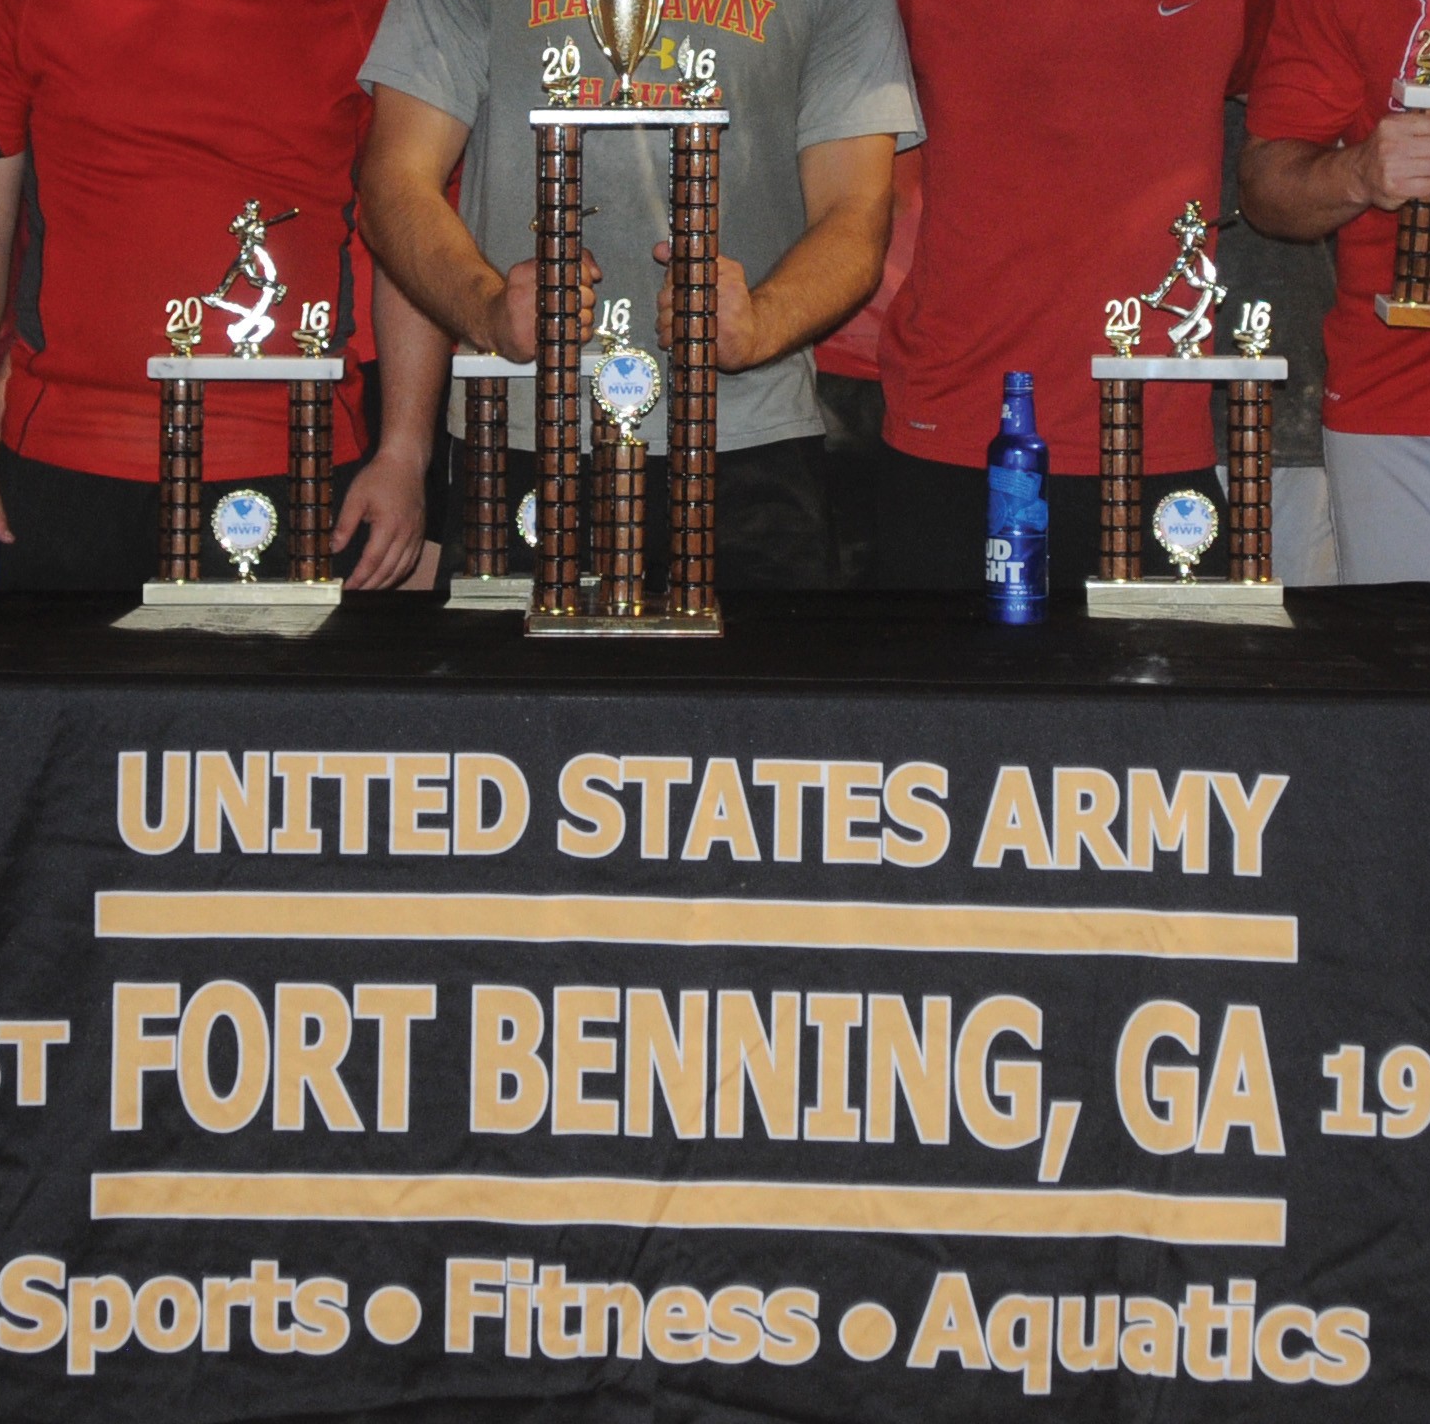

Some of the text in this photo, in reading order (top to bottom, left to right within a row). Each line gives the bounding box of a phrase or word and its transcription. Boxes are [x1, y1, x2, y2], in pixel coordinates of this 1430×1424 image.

[543, 45, 716, 82] 20 16
[166, 297, 330, 330] 20 16
[602, 298, 632, 331] 16
[1105, 297, 1271, 332] 20 16
[608, 382, 644, 396] MWR
[226, 522, 262, 537] MWR
[1168, 523, 1204, 538] MWR
[117, 751, 1291, 877] UNITED STATES ARMY
[111, 979, 437, 1133] FORT
[470, 984, 1082, 1182] BENNING,
[1115, 999, 1286, 1156] GA
[445, 1256, 820, 1361] Fitness
[906, 1271, 1371, 1395] Aquatics
